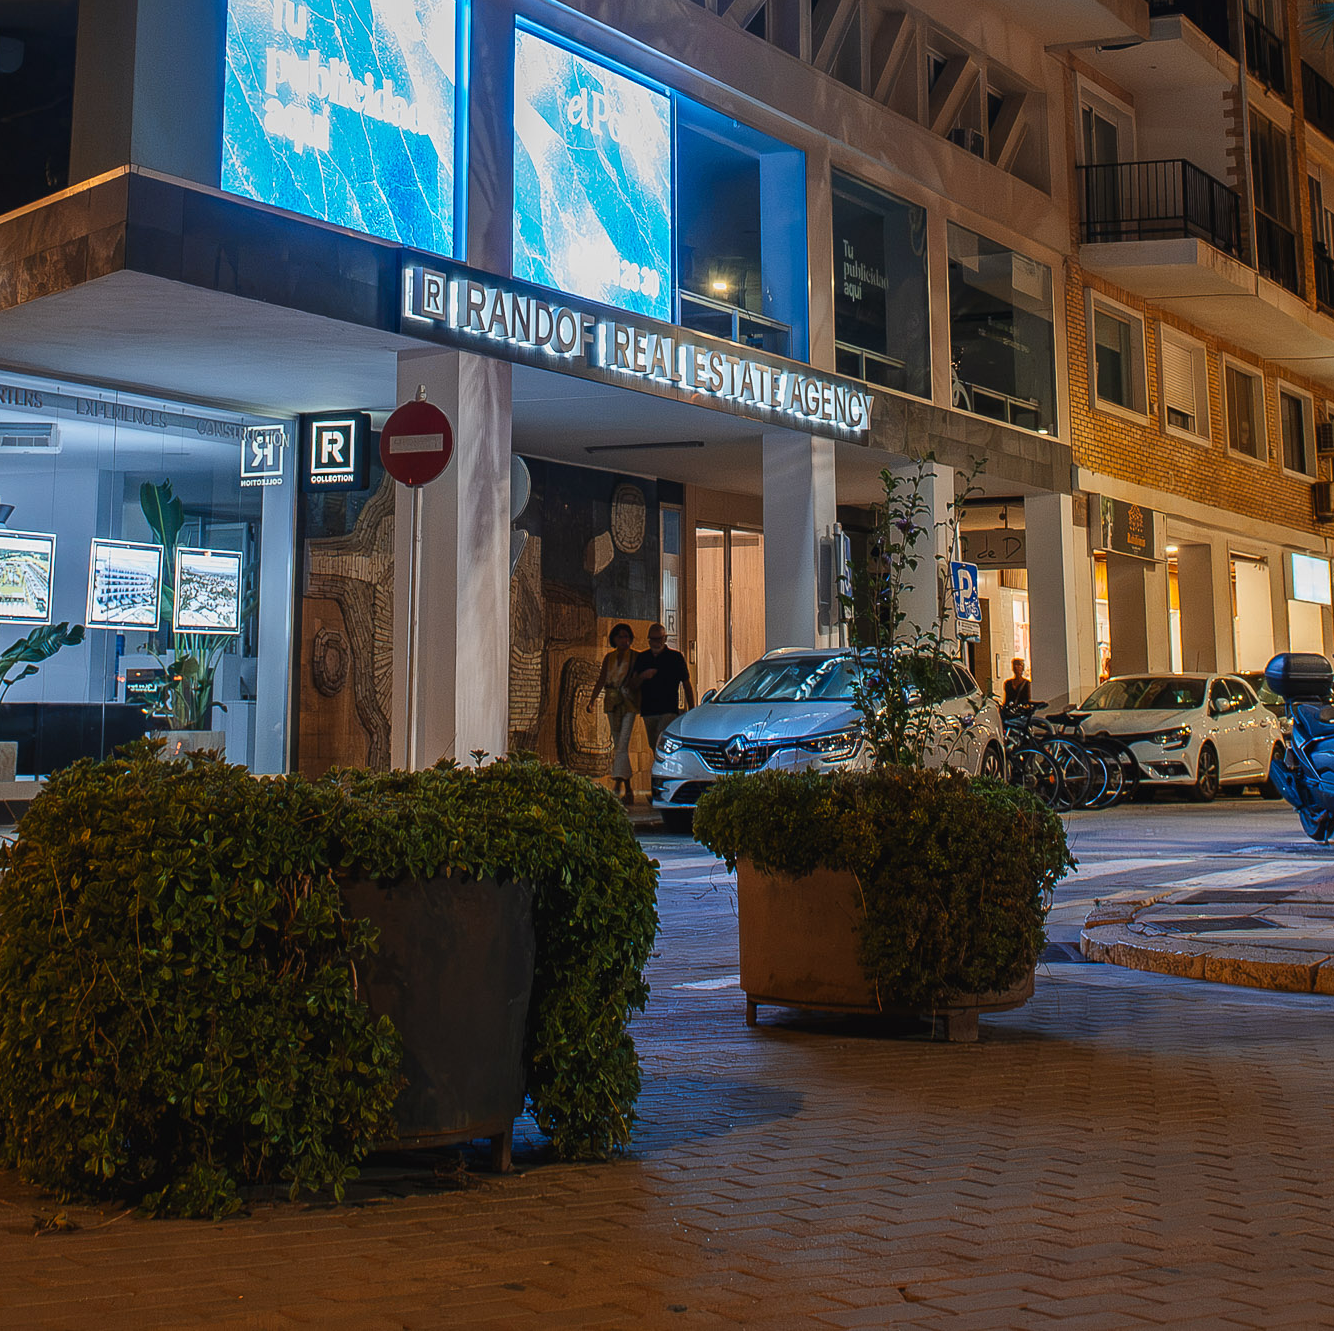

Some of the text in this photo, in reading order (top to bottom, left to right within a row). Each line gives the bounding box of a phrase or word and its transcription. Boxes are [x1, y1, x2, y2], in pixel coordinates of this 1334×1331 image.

[265, 47, 431, 136] publicidad
[843, 239, 854, 260] Tu
[460, 279, 596, 357] RANDOF
[608, 321, 683, 383] REAL
[690, 345, 782, 407] ESTATE
[783, 373, 875, 431] AGENCY
[75, 397, 168, 428] EXPERIENCES
[196, 420, 290, 448] CONSTRUCTION
[310, 474, 354, 484] COLLECTION
